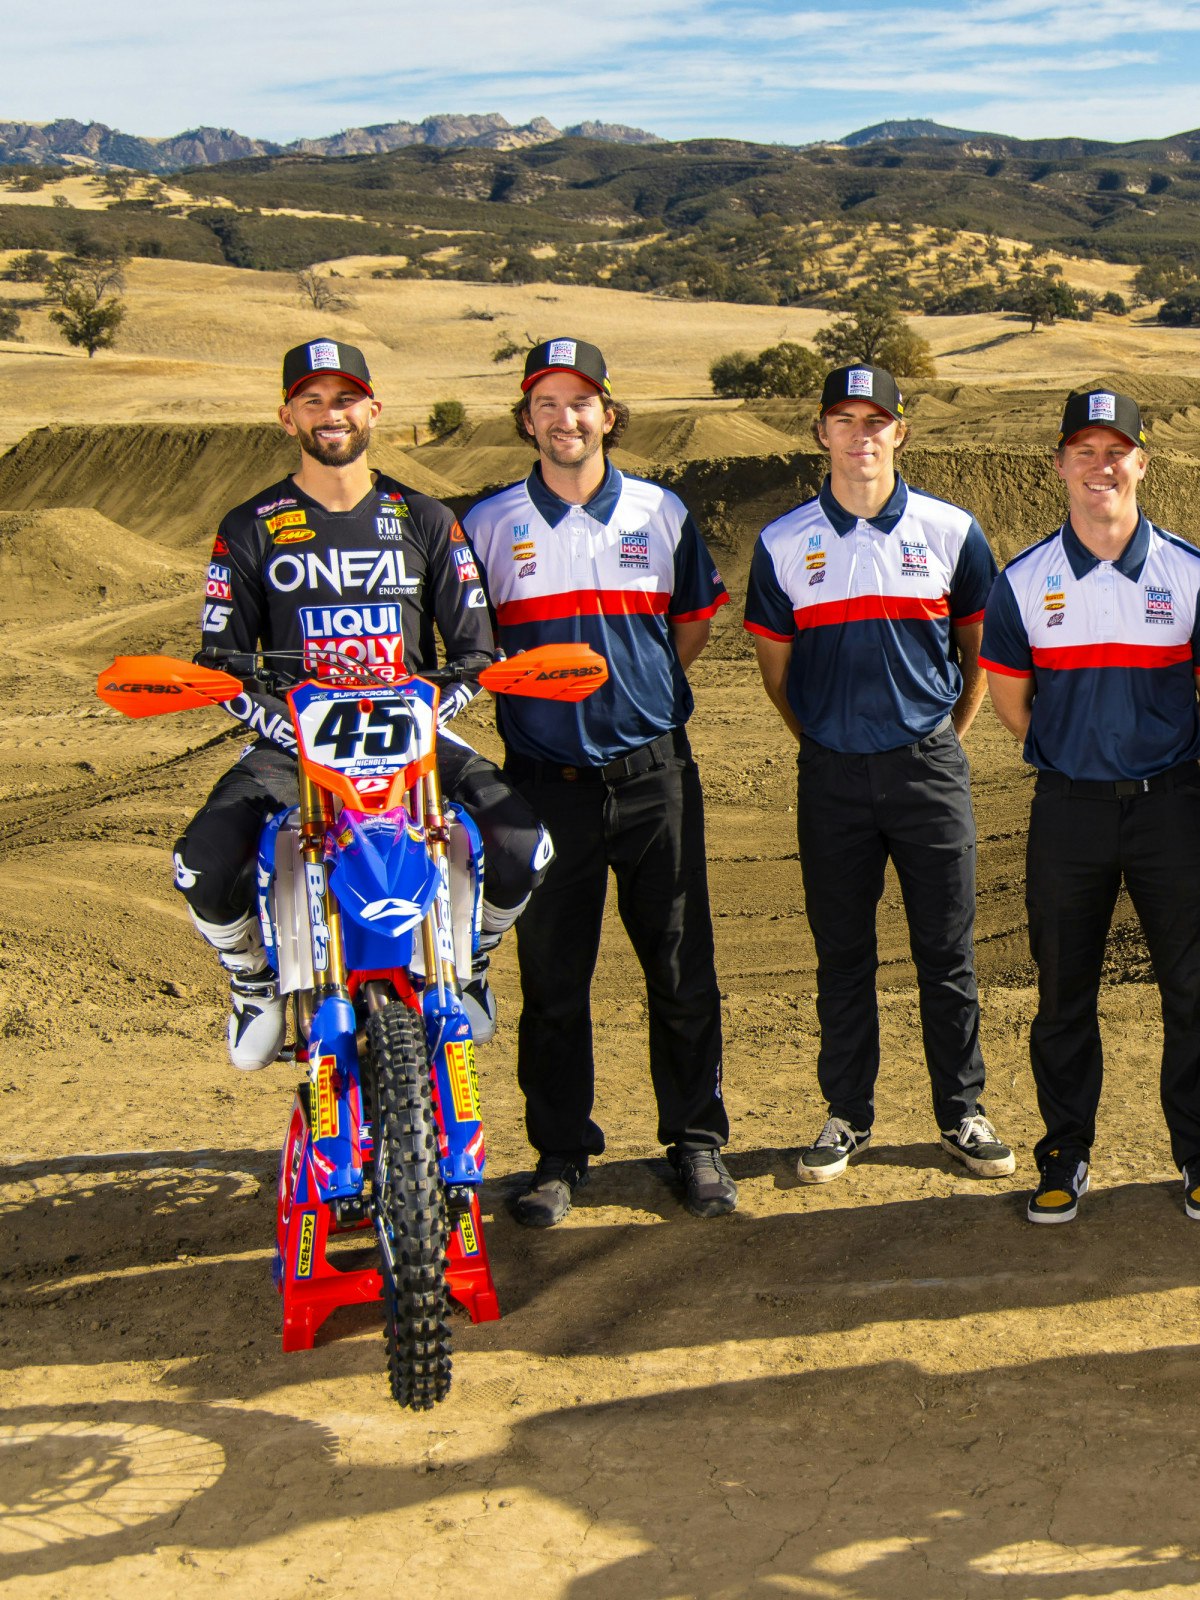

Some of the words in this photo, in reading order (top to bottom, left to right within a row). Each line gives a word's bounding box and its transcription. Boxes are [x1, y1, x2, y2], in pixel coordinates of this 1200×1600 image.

[377, 518, 402, 535] FIJI
[623, 537, 646, 546] LIQUI
[623, 545, 647, 554] MOLY
[269, 549, 420, 596] O'NEAL
[206, 581, 230, 597] OLY
[1149, 601, 1172, 609] MOLY
[305, 606, 398, 637] LIQUI
[308, 636, 402, 667] MOLY
[535, 666, 603, 681] ACERBIS
[104, 682, 184, 695] ACERBIS
[333, 690, 395, 699] SUPERCROSS
[313, 699, 416, 760] 45
[344, 766, 400, 775] Beta
[355, 758, 388, 767] NICHOLS
[304, 862, 331, 972] Beta
[445, 1043, 474, 1121] PIRELLI
[299, 1216, 314, 1275] ACERBIS
